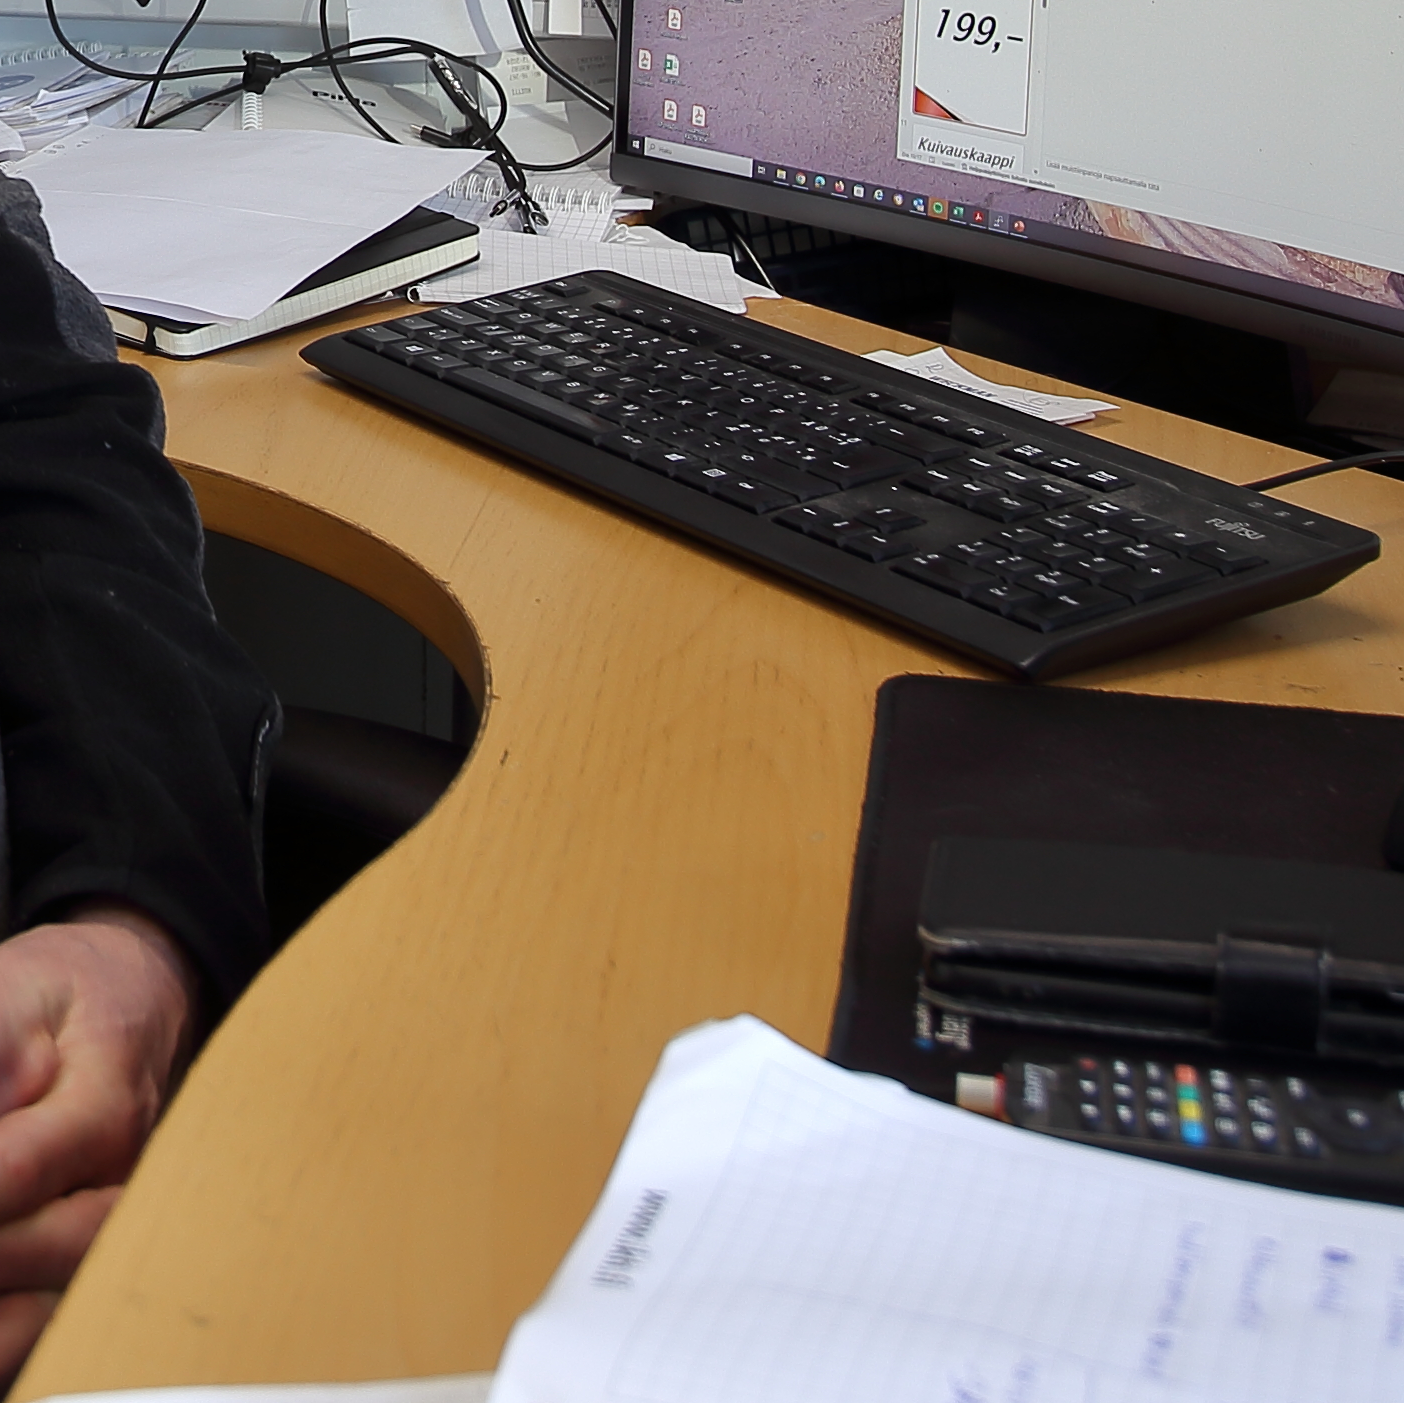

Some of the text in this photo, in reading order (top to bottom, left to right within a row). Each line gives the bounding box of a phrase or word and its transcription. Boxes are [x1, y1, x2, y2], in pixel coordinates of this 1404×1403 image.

[934, 8, 1024, 53] 199,-
[917, 136, 1016, 170] Kuivauskaappi
[1205, 516, 1266, 542] FUJITSU
